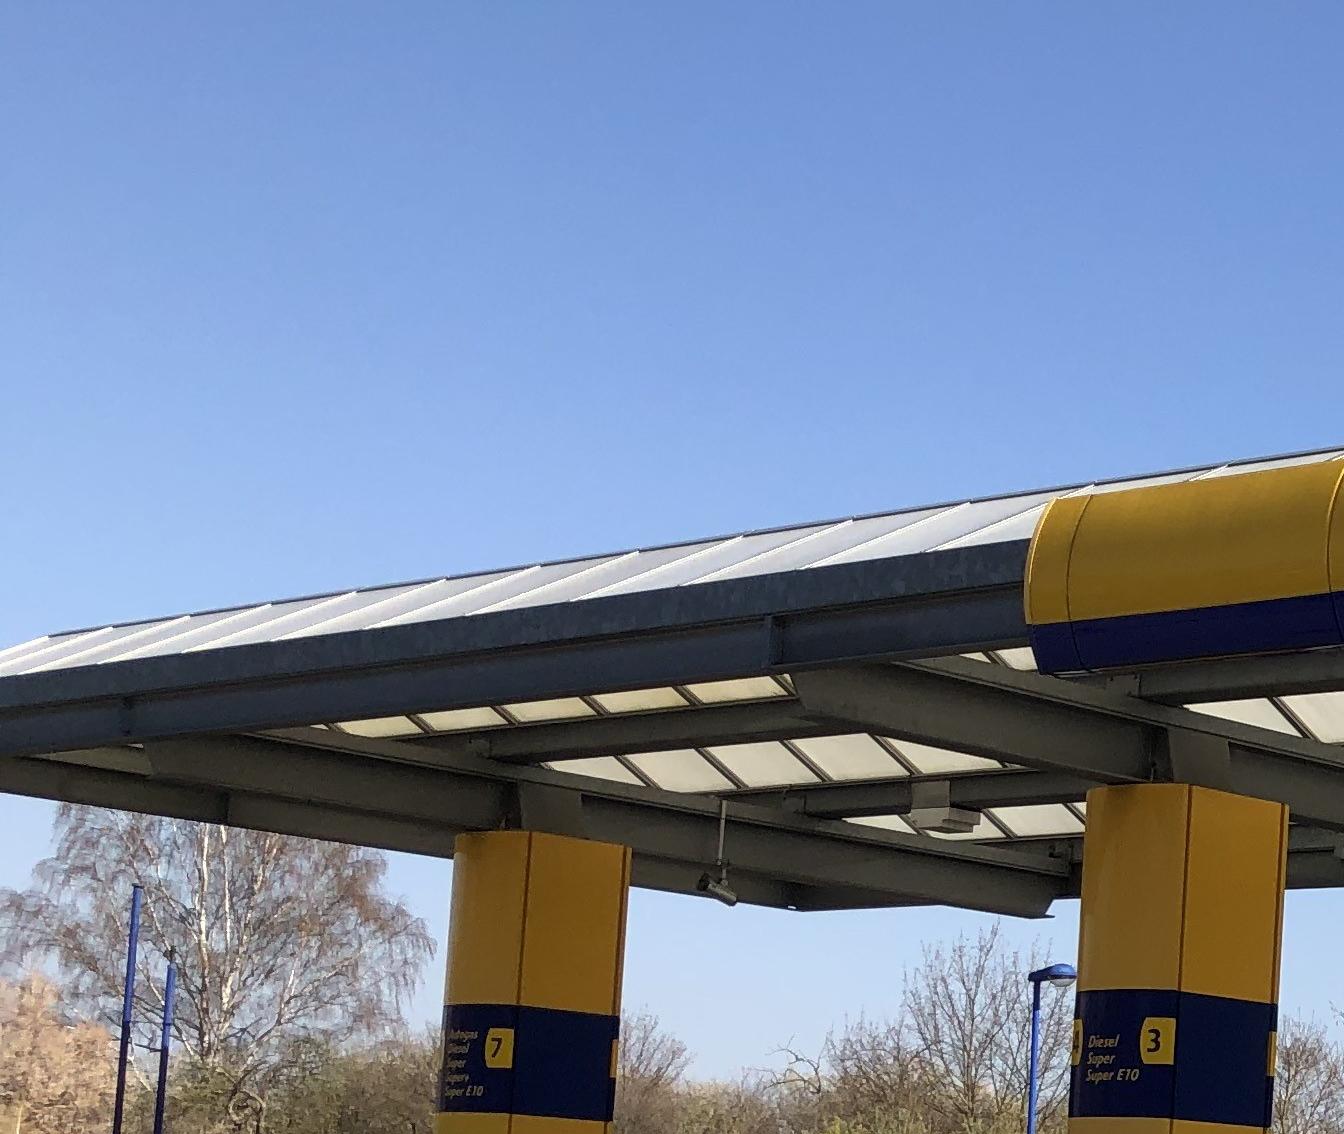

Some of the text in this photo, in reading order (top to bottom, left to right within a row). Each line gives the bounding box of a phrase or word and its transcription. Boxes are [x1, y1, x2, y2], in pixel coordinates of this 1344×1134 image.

[491, 1037, 503, 1058] 7
[1088, 1034, 1120, 1048] Diesel
[1147, 1028, 1161, 1053] 3
[1086, 1052, 1115, 1068] Super
[1086, 1069, 1140, 1085] Super E10
